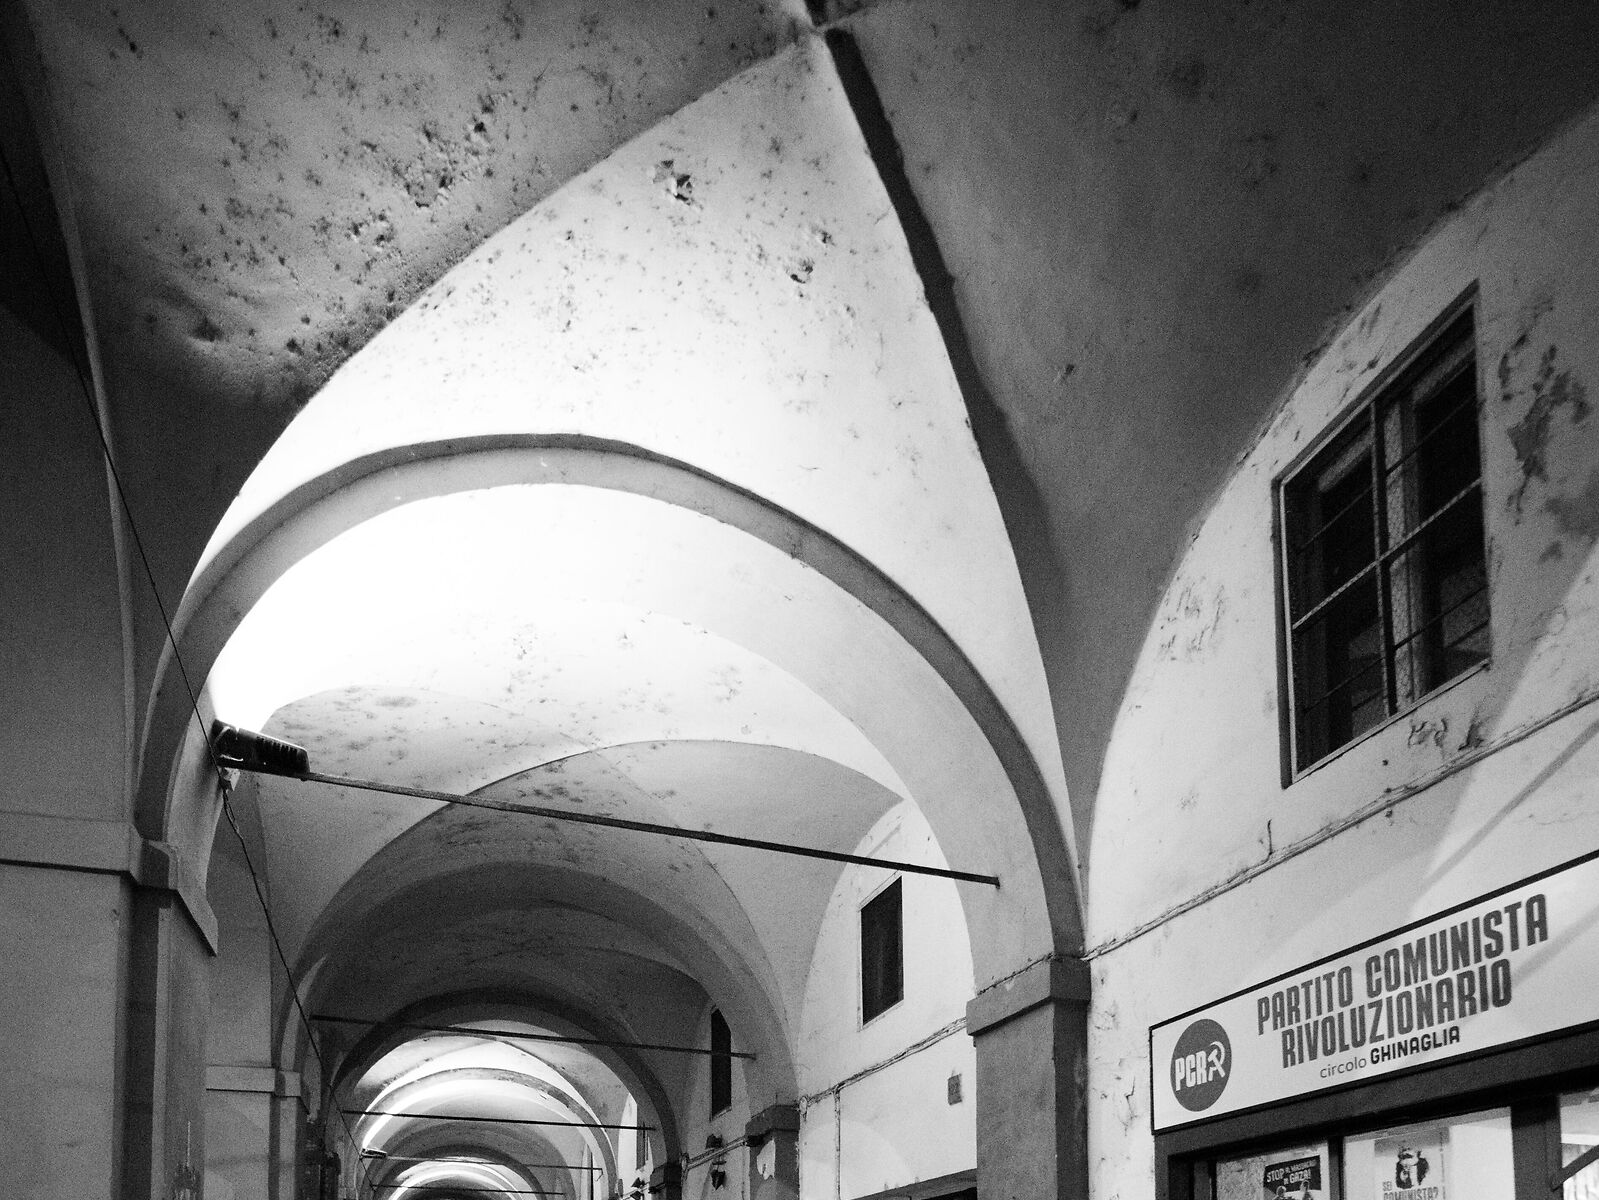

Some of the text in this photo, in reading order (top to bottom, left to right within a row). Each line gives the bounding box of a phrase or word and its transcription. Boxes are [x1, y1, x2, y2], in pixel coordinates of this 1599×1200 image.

[1257, 893, 1548, 1035] PARTITO COMUNISTA
[1281, 958, 1512, 1069] RIVOLUZIONARIO
[1175, 1050, 1207, 1091] PCR
[1320, 1026, 1460, 1078] circolo GHINAGLIA
[1266, 1168, 1285, 1183] STOP
[1289, 1168, 1312, 1184] GAZA!
